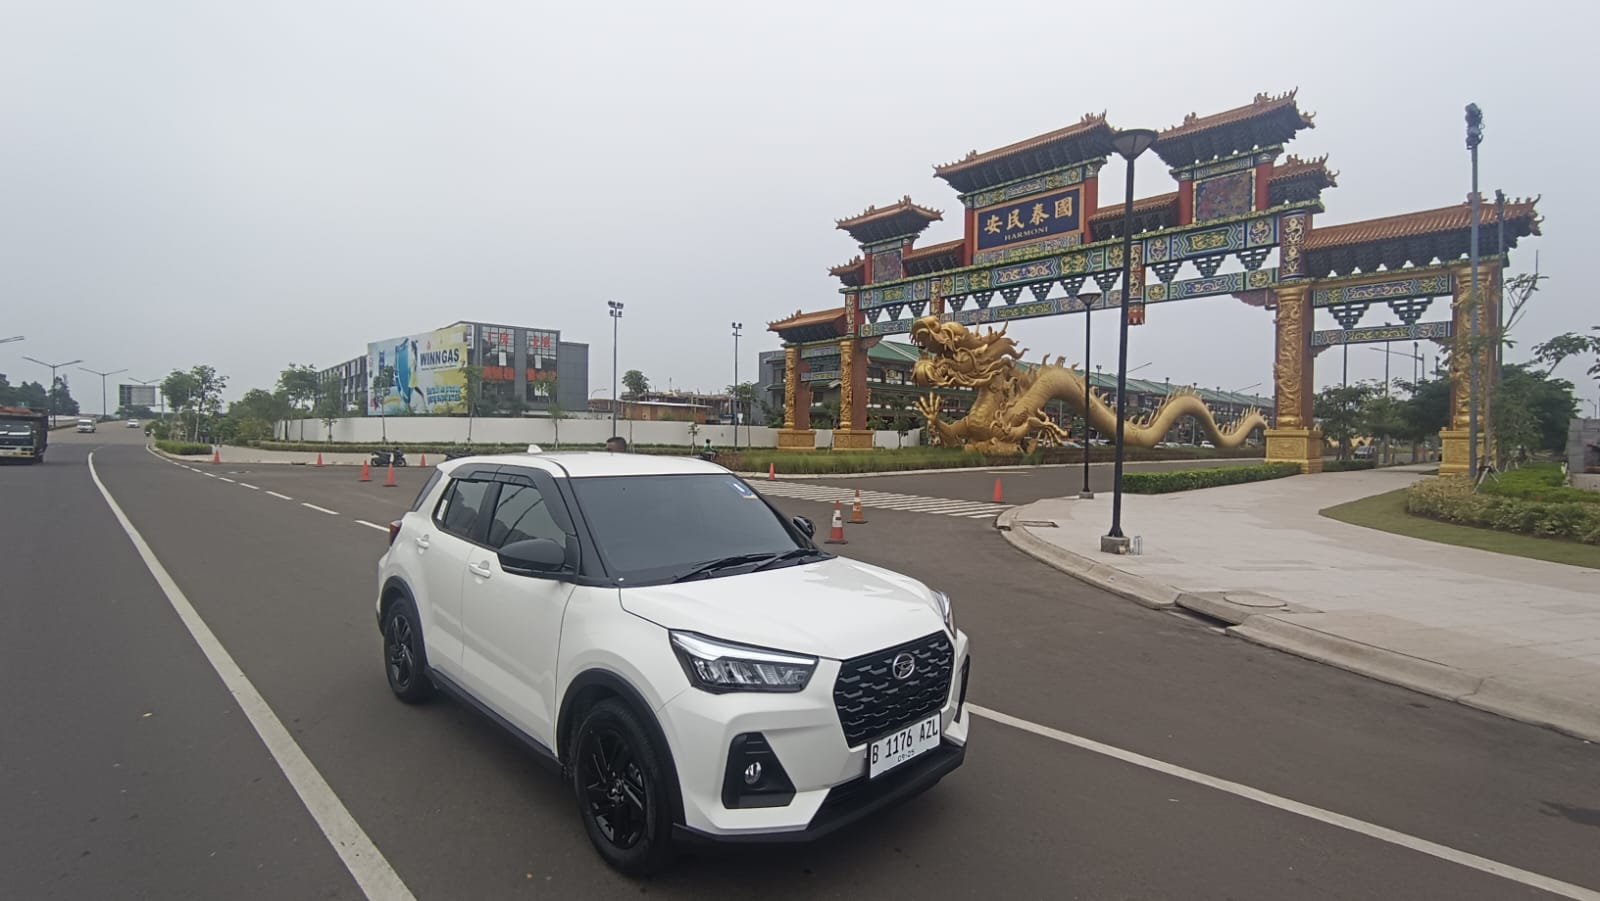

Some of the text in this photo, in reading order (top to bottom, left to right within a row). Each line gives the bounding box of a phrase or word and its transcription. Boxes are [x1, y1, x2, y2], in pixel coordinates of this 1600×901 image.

[1004, 226, 1048, 240] HARMONI
[872, 719, 938, 765] B 1176 AZL
